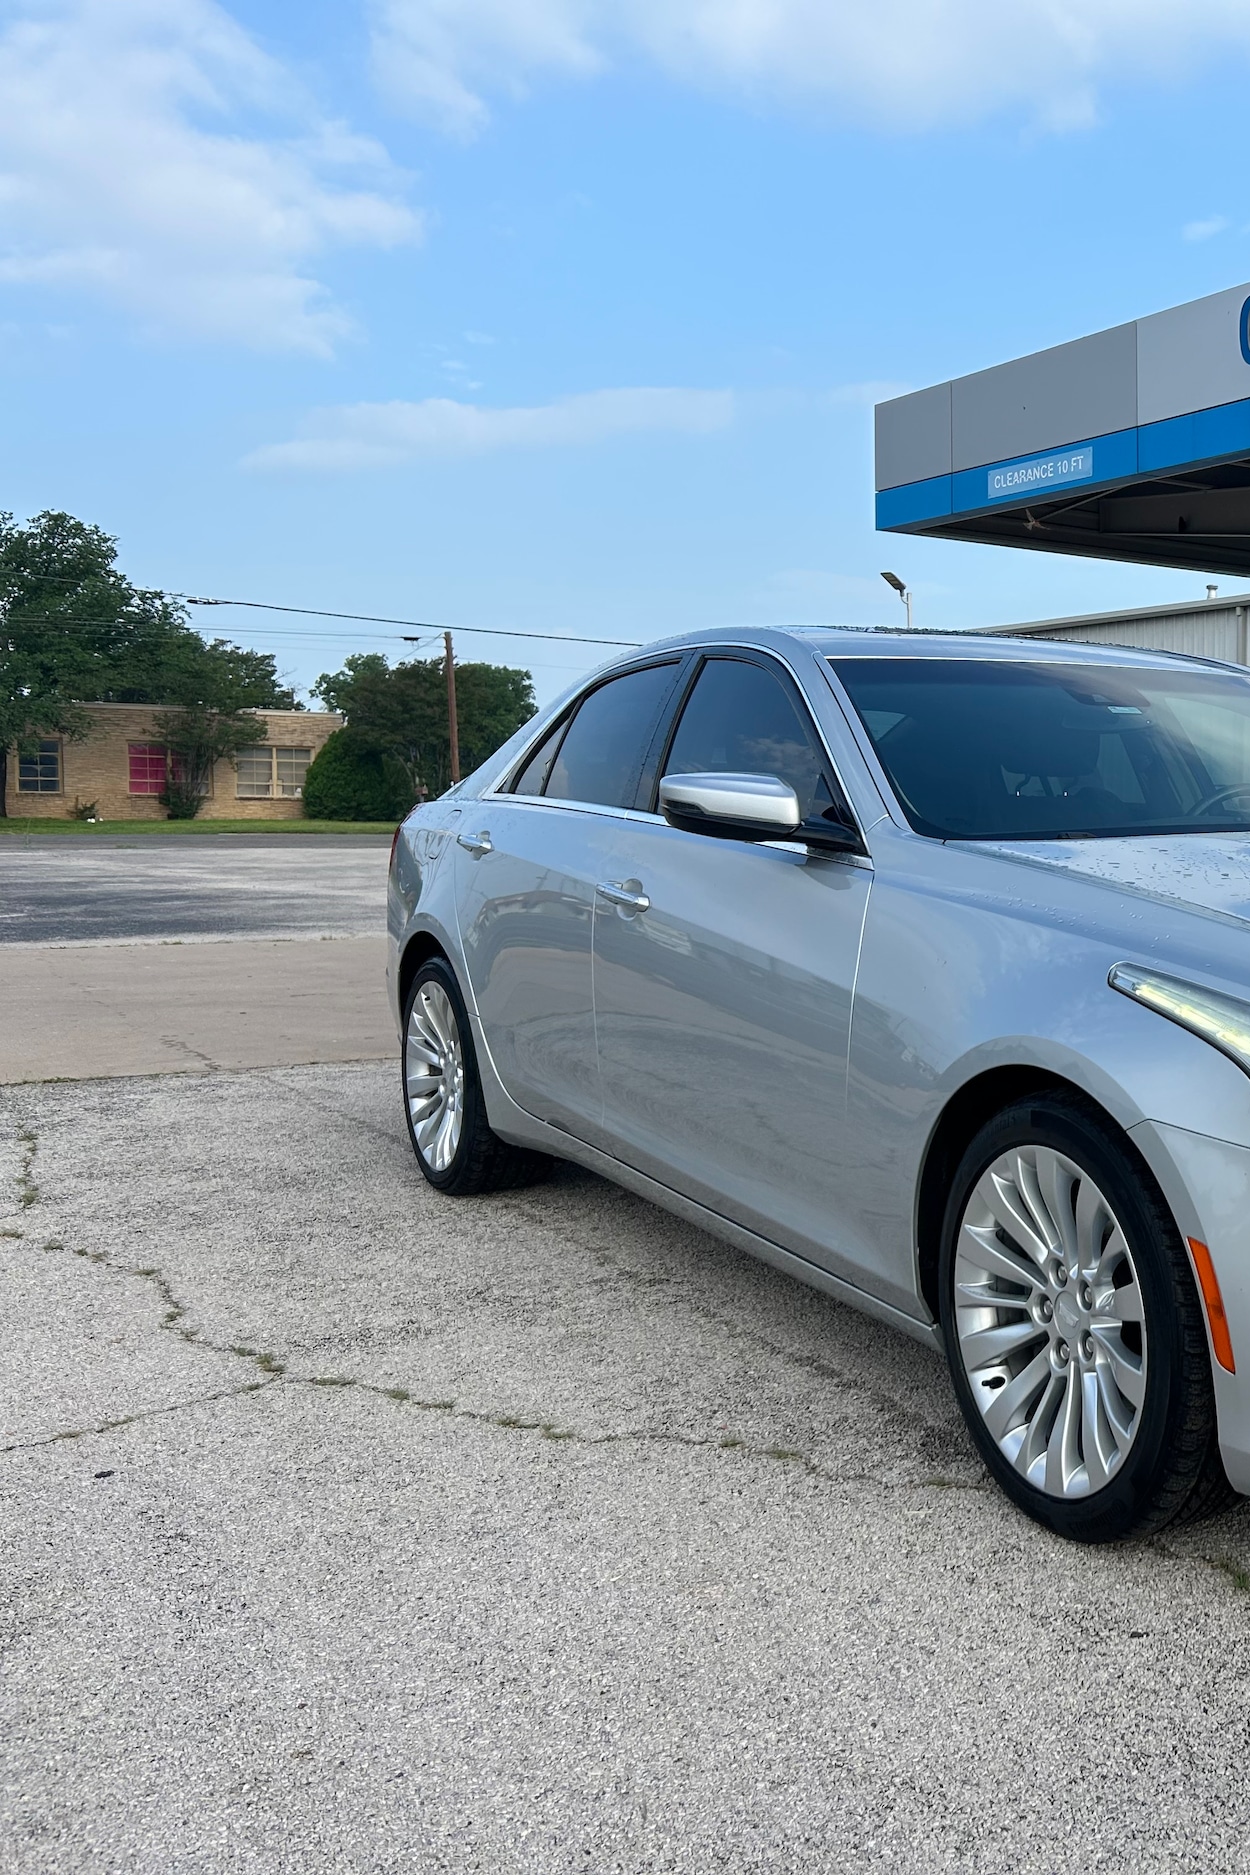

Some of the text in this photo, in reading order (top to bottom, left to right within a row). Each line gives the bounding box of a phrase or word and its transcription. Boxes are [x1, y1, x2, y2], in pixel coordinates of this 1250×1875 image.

[994, 456, 1084, 489] CLEARANCE 10 FT
